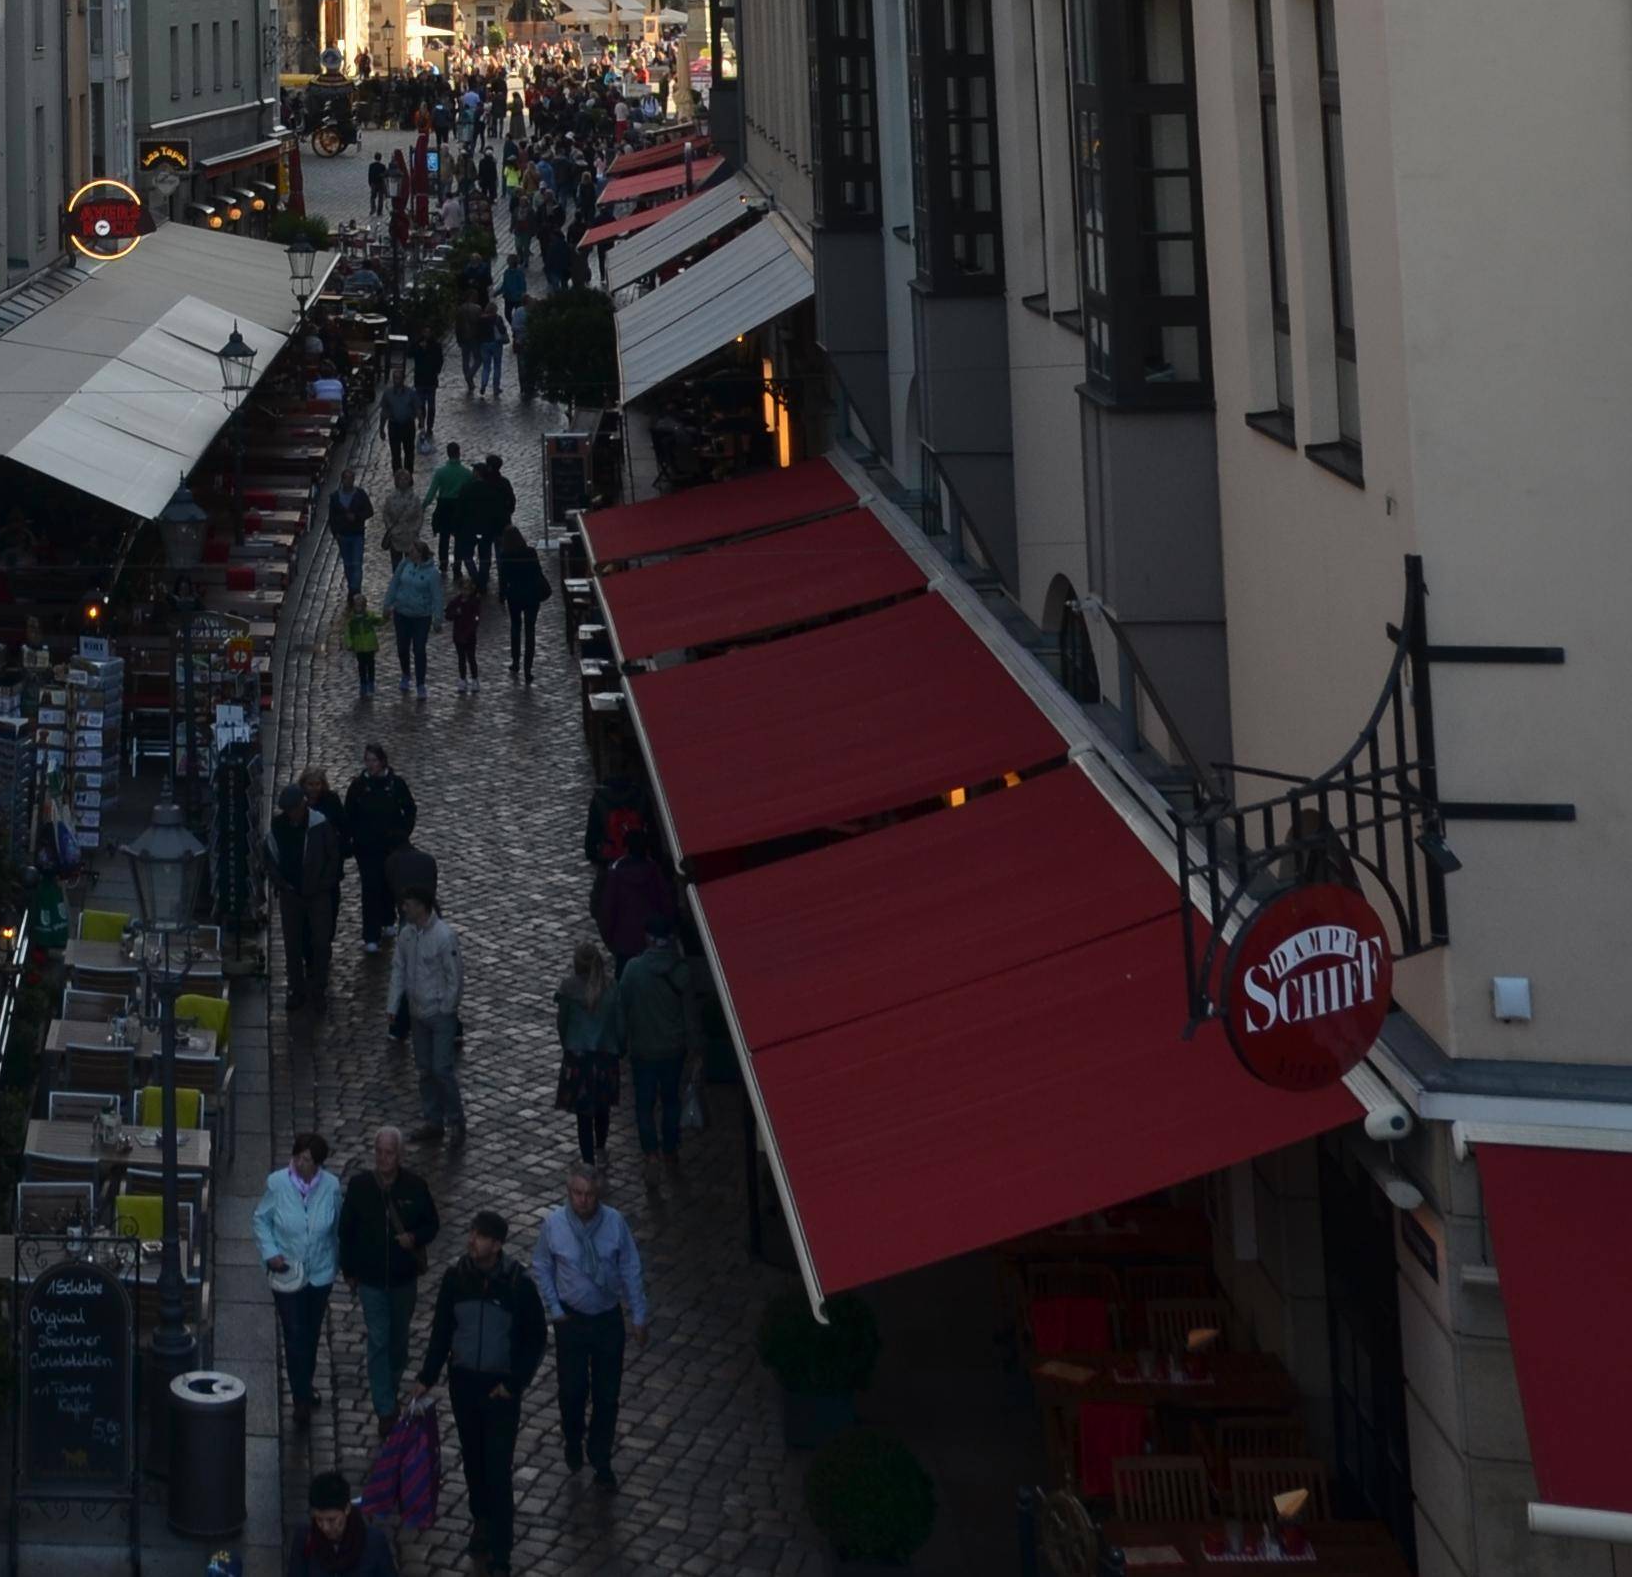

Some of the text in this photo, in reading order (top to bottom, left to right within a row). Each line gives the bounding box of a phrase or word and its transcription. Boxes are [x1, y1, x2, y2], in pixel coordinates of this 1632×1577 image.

[160, 146, 188, 167] Tapas
[1270, 928, 1357, 981] DAMPF
[1244, 935, 1384, 1034] SCHIFF
[29, 1305, 86, 1336] Original
